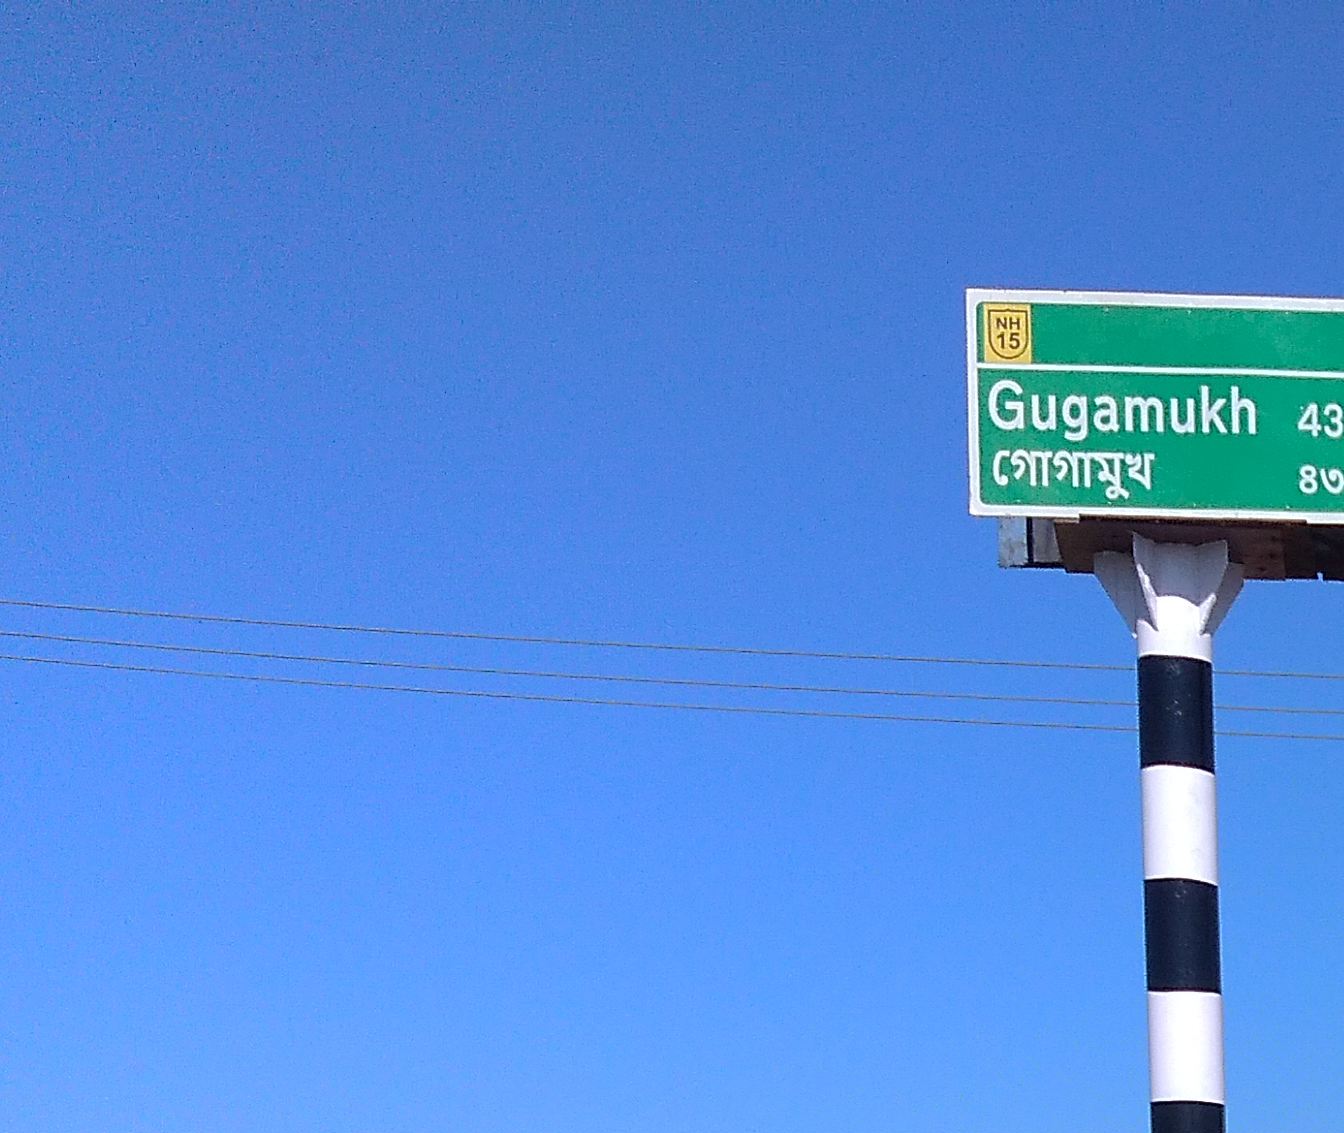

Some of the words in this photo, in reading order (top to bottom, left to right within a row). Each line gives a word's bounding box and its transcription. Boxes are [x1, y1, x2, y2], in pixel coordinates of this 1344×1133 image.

[997, 317, 1020, 330] NH
[997, 332, 1020, 349] 15
[989, 380, 1256, 441] Gugamukh
[1298, 404, 1343, 437] 43
[993, 449, 1154, 499] গোগামুখ
[1300, 465, 1344, 493] ৪৩
